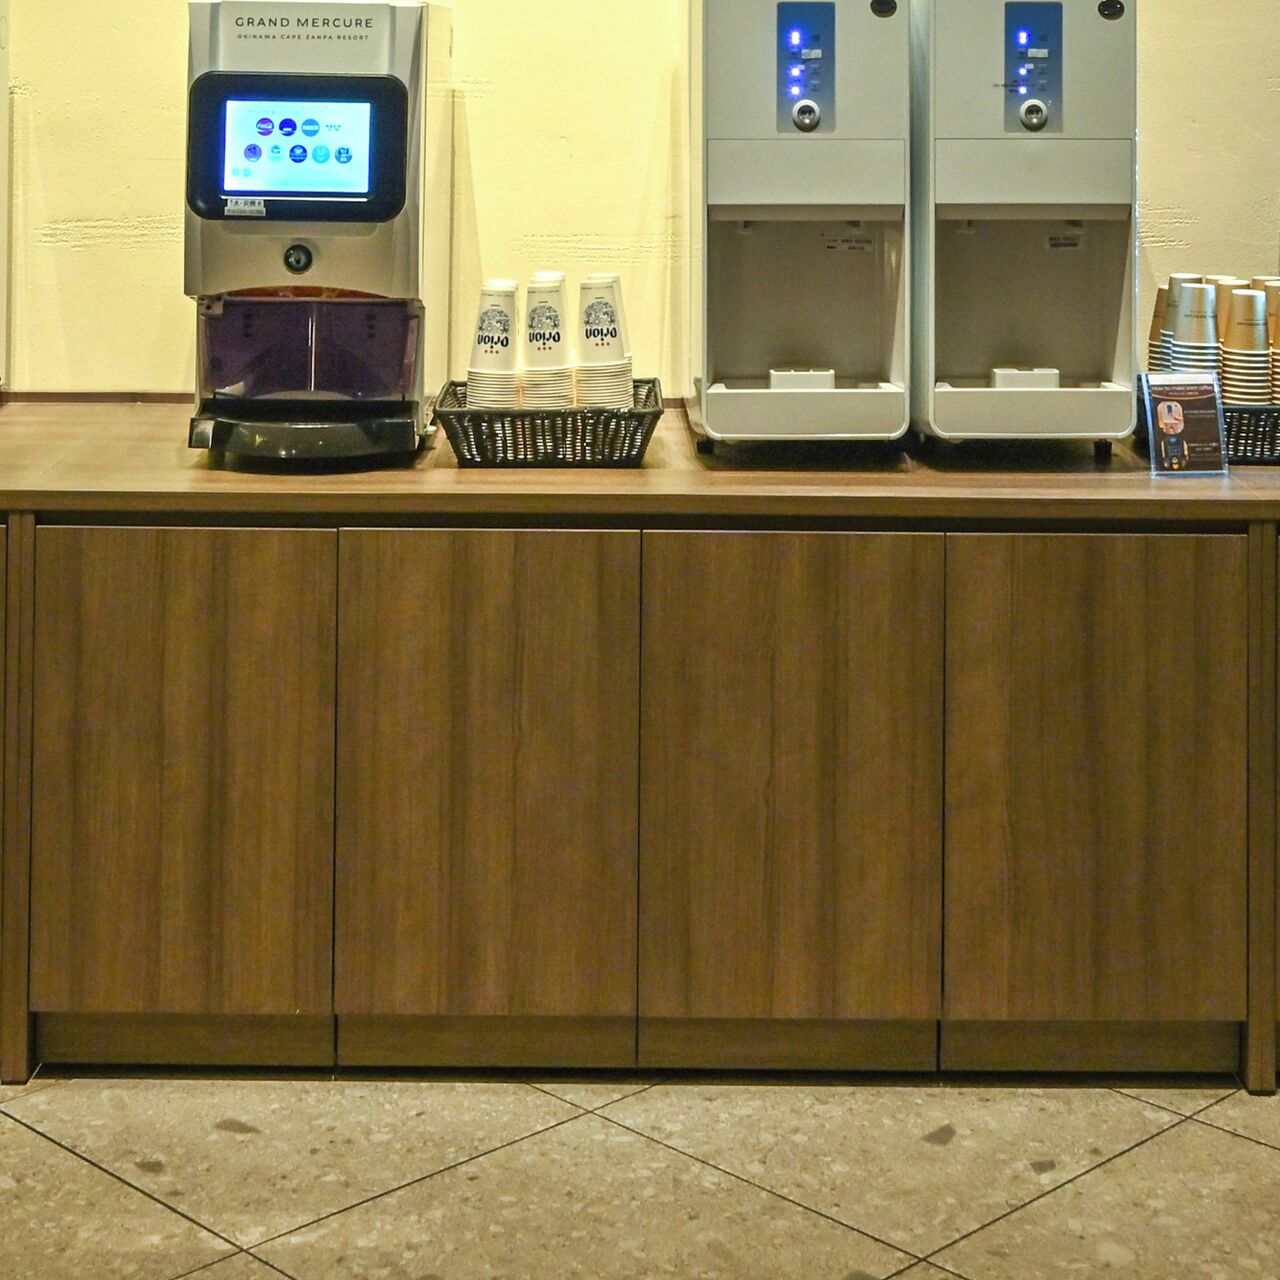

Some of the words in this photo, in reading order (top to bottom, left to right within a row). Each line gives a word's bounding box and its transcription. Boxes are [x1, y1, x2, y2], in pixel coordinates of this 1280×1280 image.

[235, 17, 290, 27] GRAND
[297, 18, 373, 28] MERCURE
[477, 334, 509, 349] Orion
[528, 331, 561, 346] Orion
[585, 327, 617, 342] Orion
